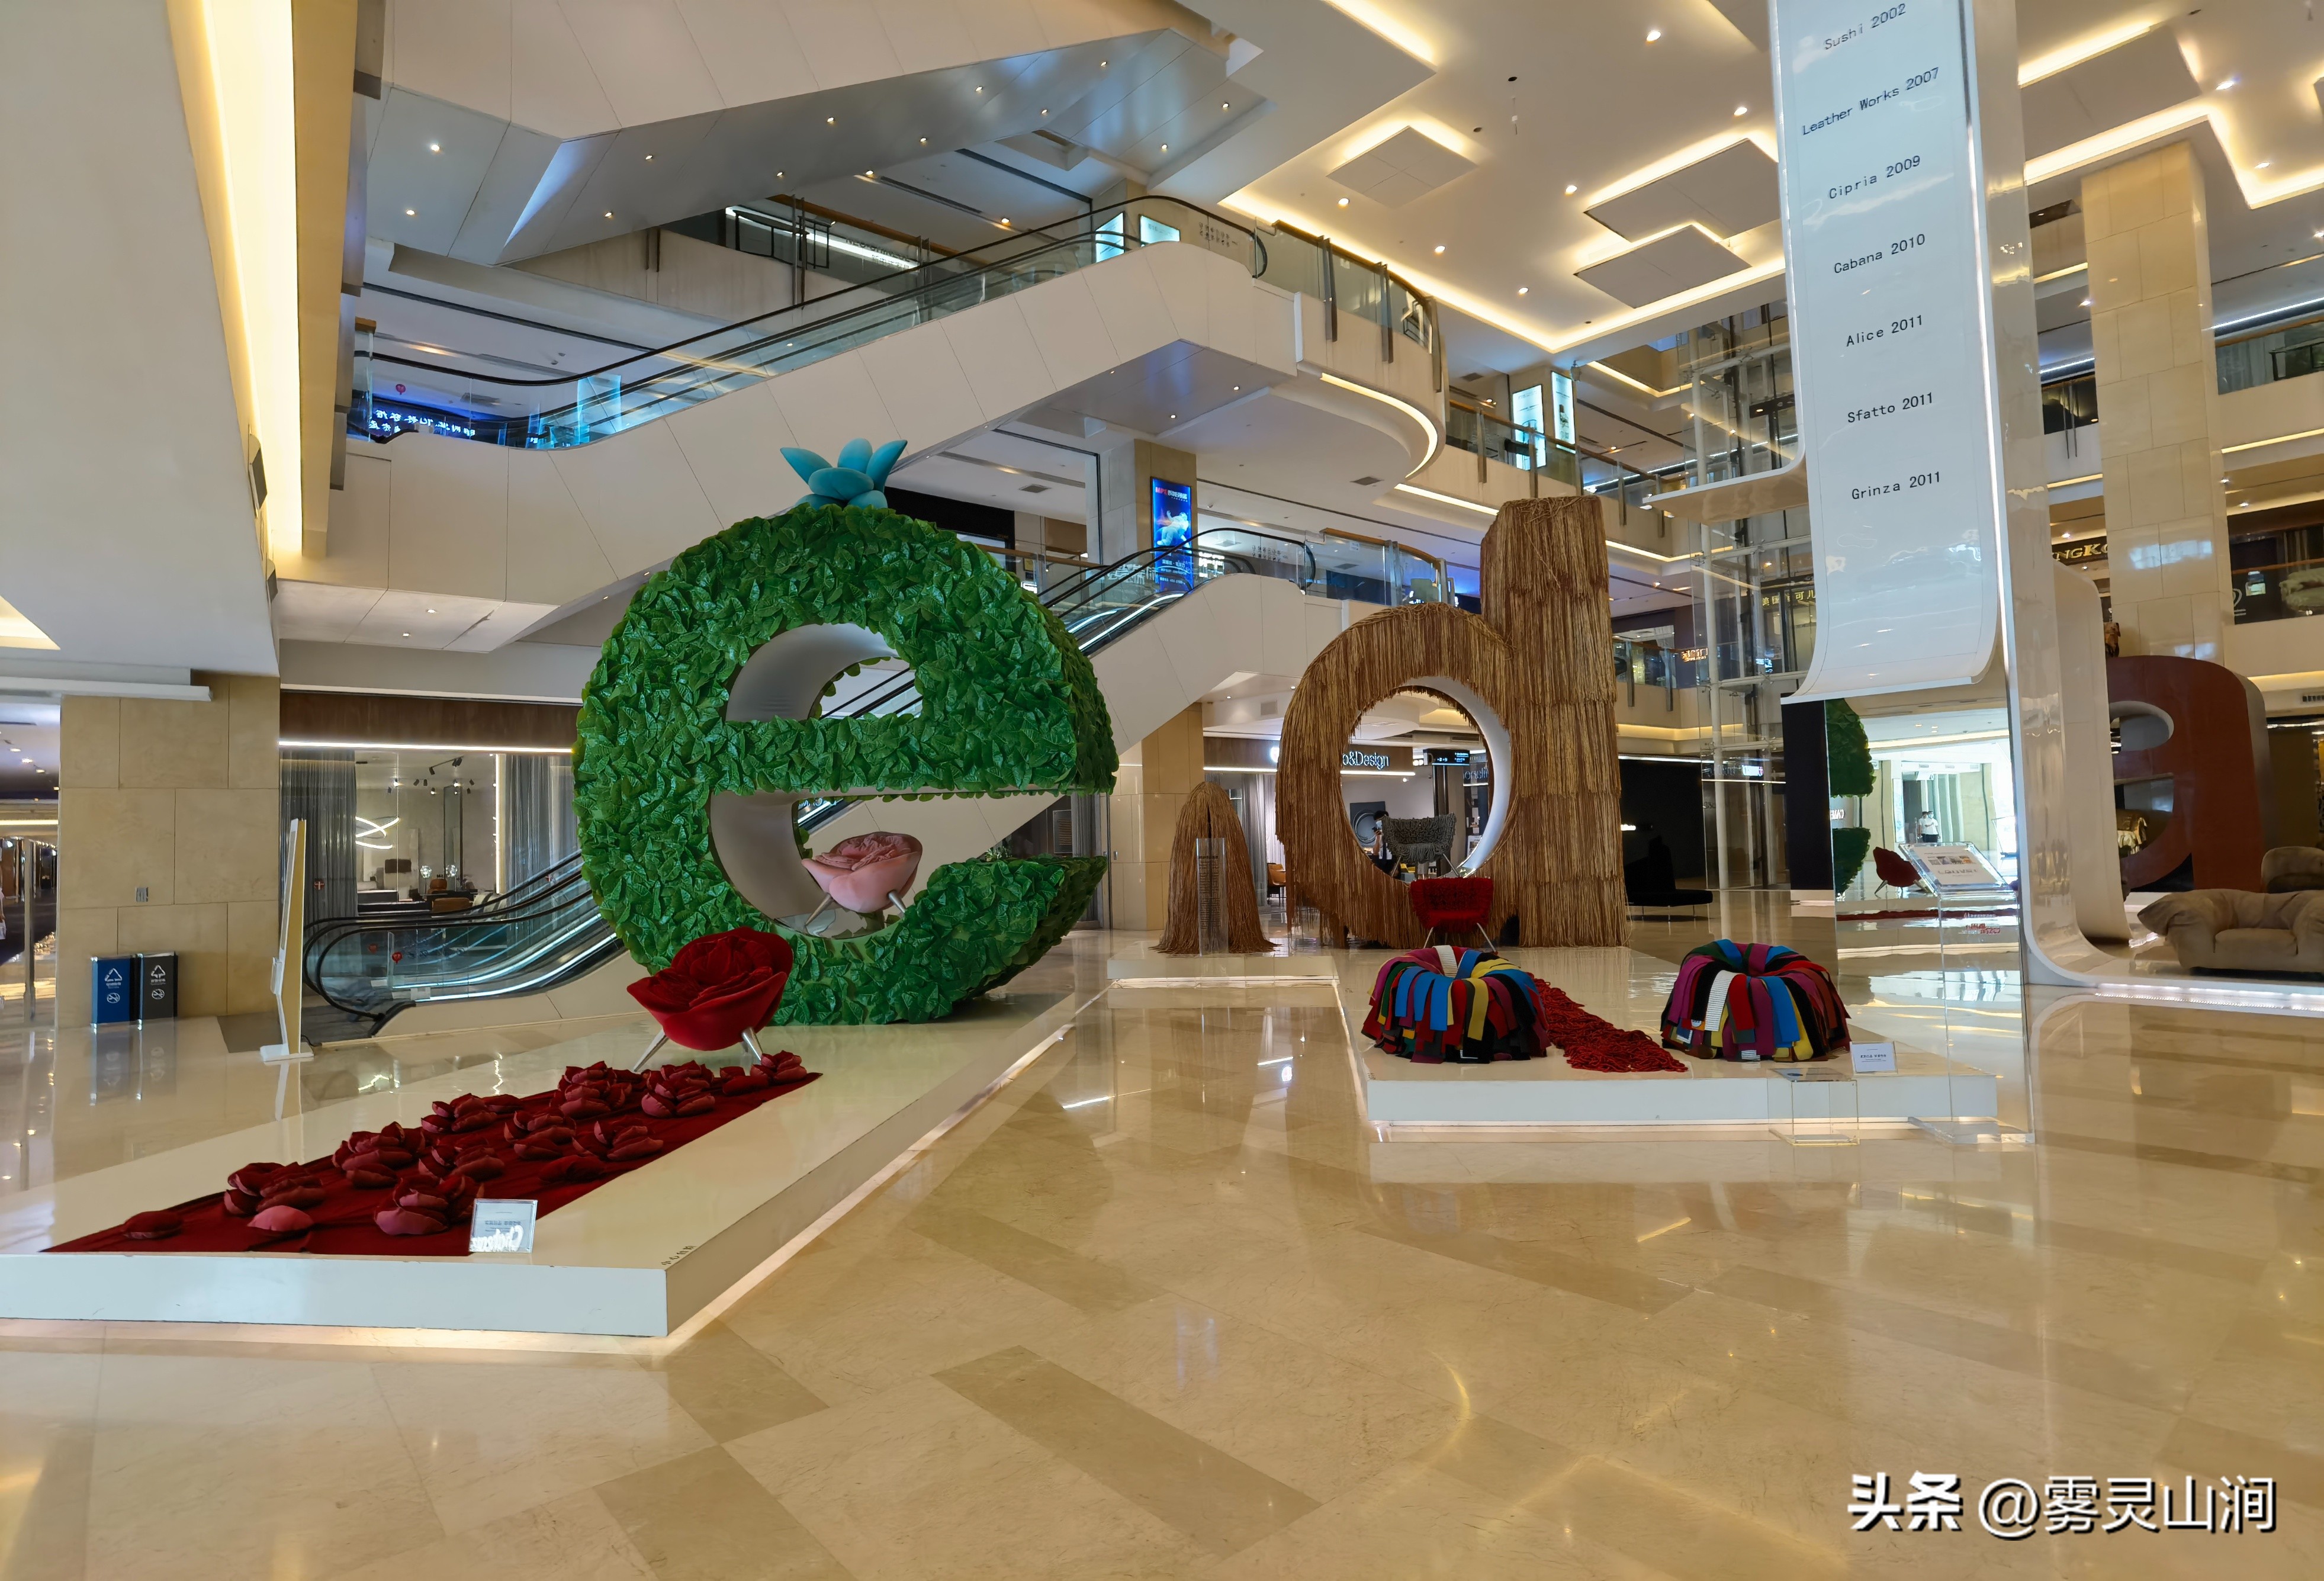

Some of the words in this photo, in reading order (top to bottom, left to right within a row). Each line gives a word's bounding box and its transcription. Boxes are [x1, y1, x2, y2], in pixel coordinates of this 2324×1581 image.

[1824, 24, 1863, 50] Sushi
[1870, 4, 1907, 28] 2002
[1802, 107, 1853, 136] Leather
[1859, 88, 1899, 111] Works
[1905, 67, 1939, 91] 2007
[1828, 175, 1878, 200] Cipria
[1886, 155, 1920, 178] 2009
[1834, 250, 1883, 274] Cabana
[1891, 233, 1926, 255] 2010
[1846, 327, 1884, 347] Alice
[1891, 315, 1923, 334] 2011
[1847, 404, 1895, 423] Sfatto
[1902, 392, 1933, 410] 2011
[1852, 482, 1901, 500] Grinza
[1910, 471, 1940, 489] 2011
